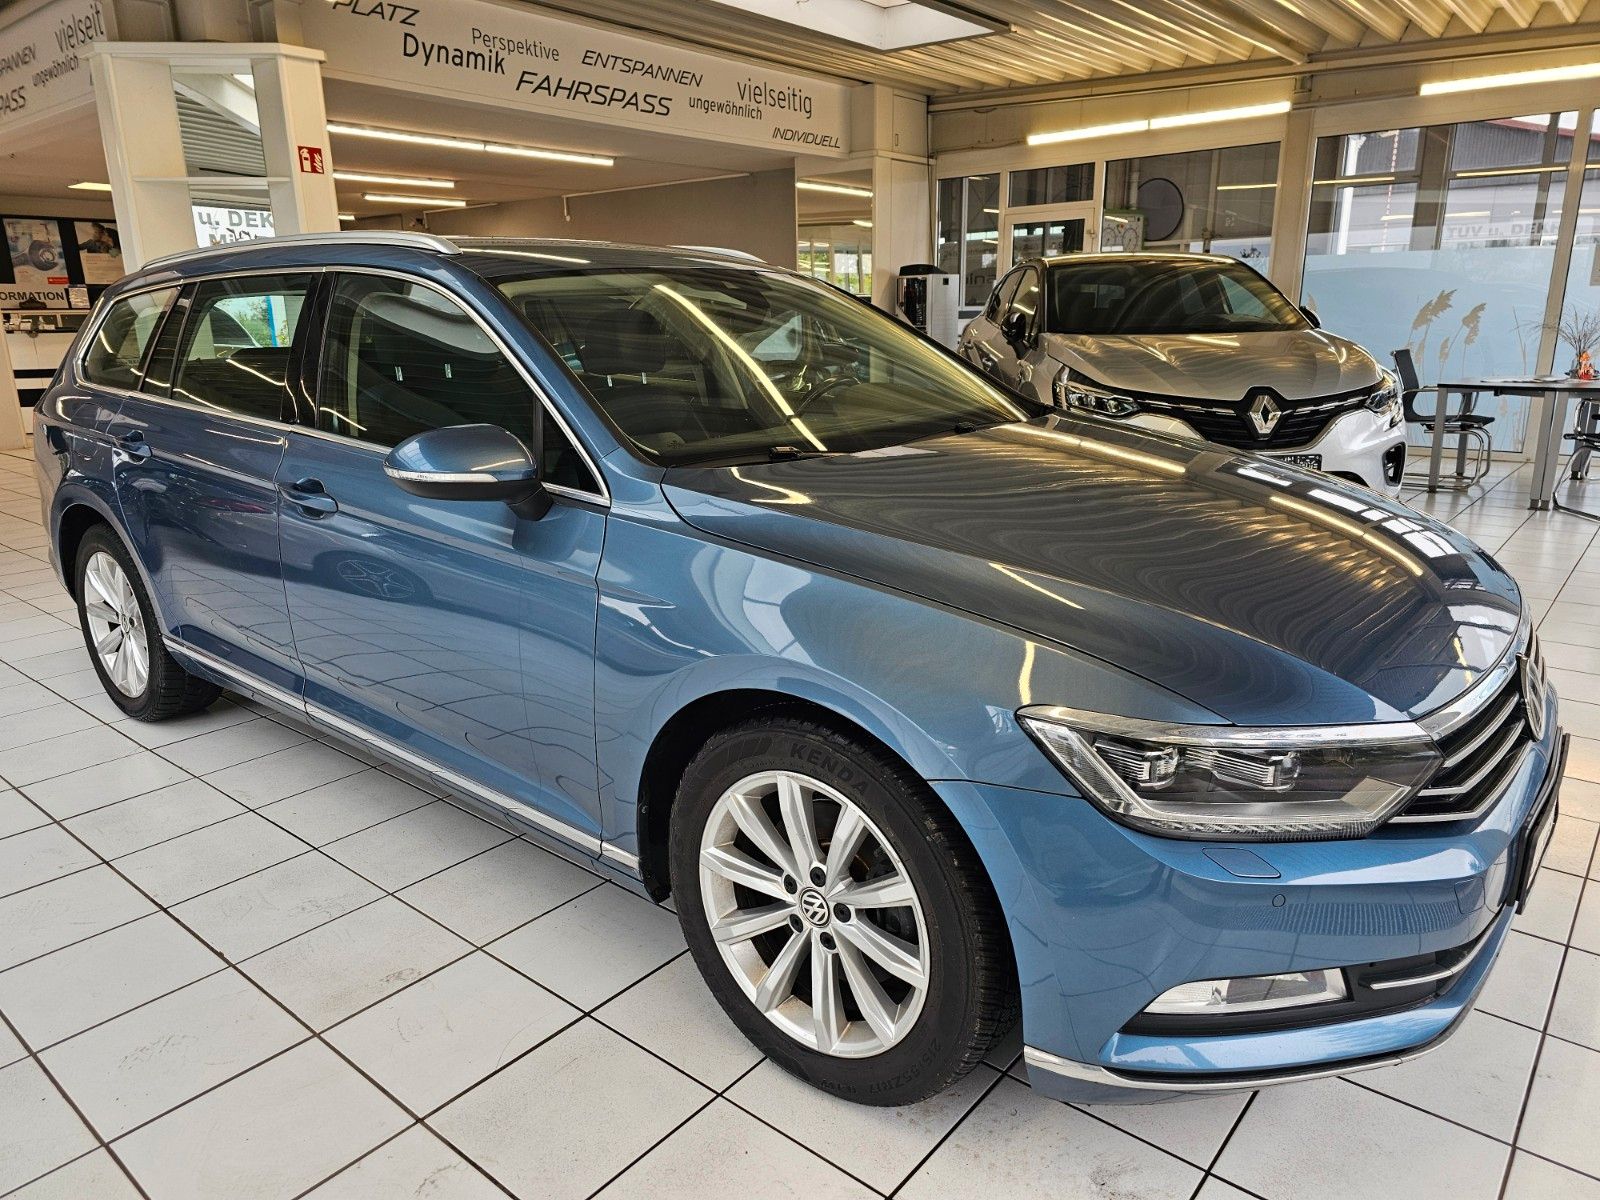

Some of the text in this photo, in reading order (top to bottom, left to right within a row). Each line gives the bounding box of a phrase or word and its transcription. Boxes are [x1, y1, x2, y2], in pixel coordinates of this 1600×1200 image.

[403, 31, 506, 75] Dynamik
[472, 27, 560, 61] Perspektive
[581, 49, 704, 88] ENTSPANNEN
[515, 70, 673, 116] FAHRSPASS
[688, 95, 763, 120] ungewöhnlich
[736, 78, 813, 119] vielseitig
[772, 126, 841, 149] INDIVIDUELL
[790, 742, 869, 796] KENDA
